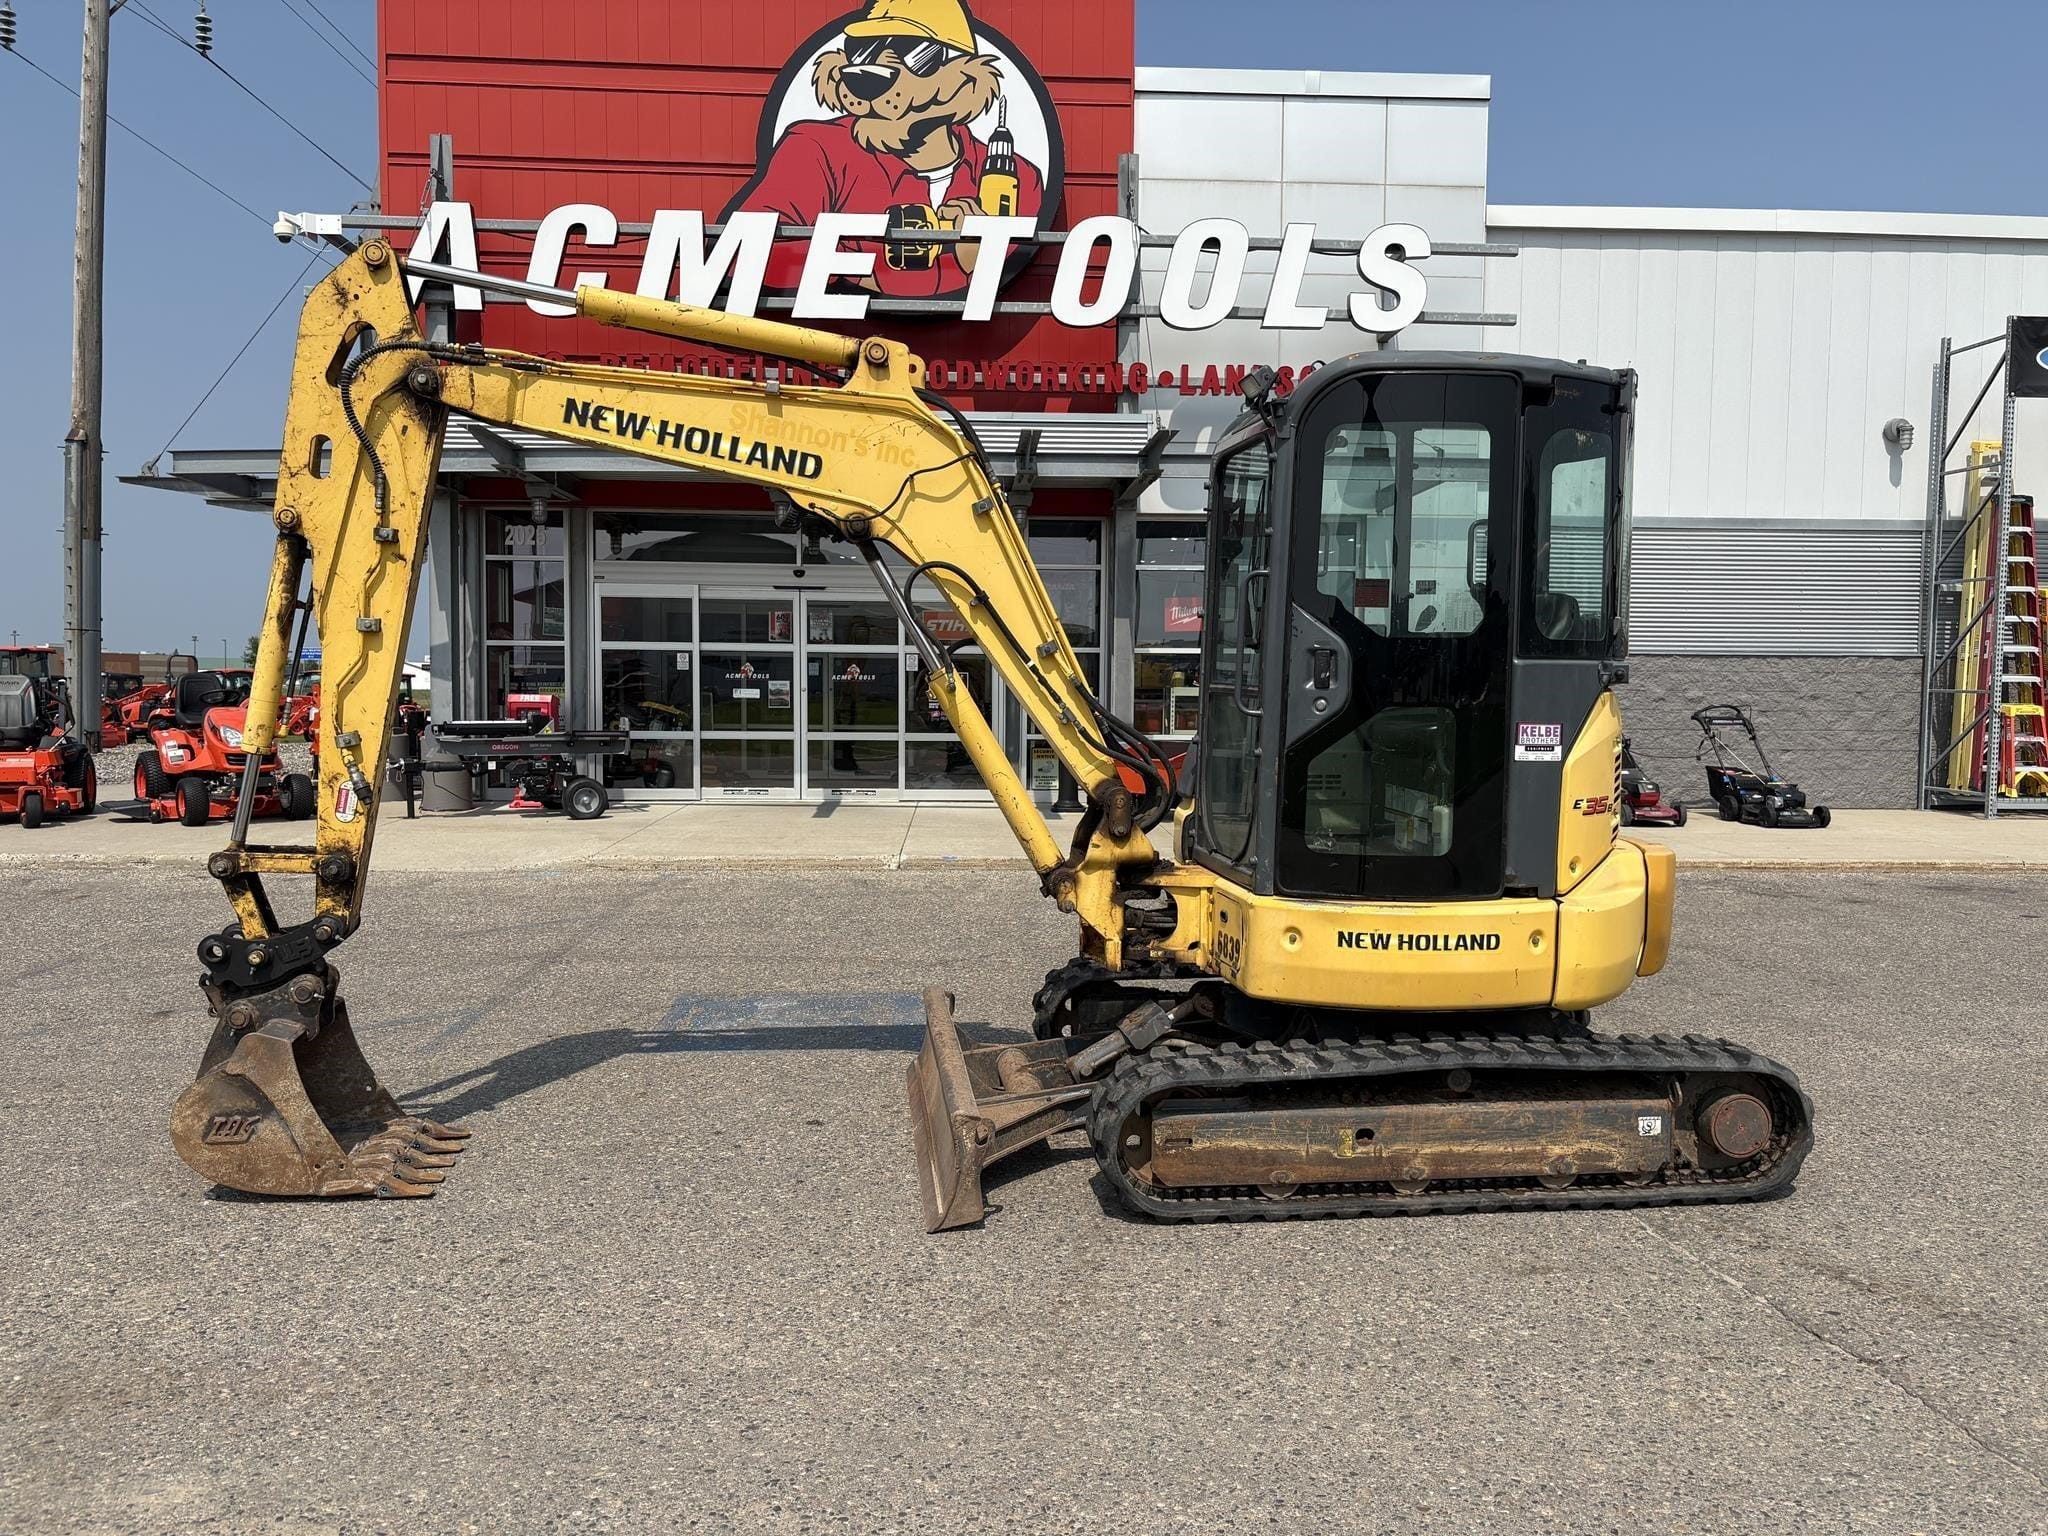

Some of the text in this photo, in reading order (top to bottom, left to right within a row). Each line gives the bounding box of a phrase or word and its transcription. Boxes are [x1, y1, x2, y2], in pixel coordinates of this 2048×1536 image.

[407, 201, 1431, 333] ACME TOOLS
[563, 397, 823, 480] NEW HOLLAND
[728, 402, 870, 457] Shannon's
[926, 619, 968, 632] STIH
[1521, 725, 1560, 737] KELBE
[491, 742, 519, 750] OREGON
[1217, 929, 1241, 965] 6839
[1337, 930, 1501, 952] NEW HOLLAND
